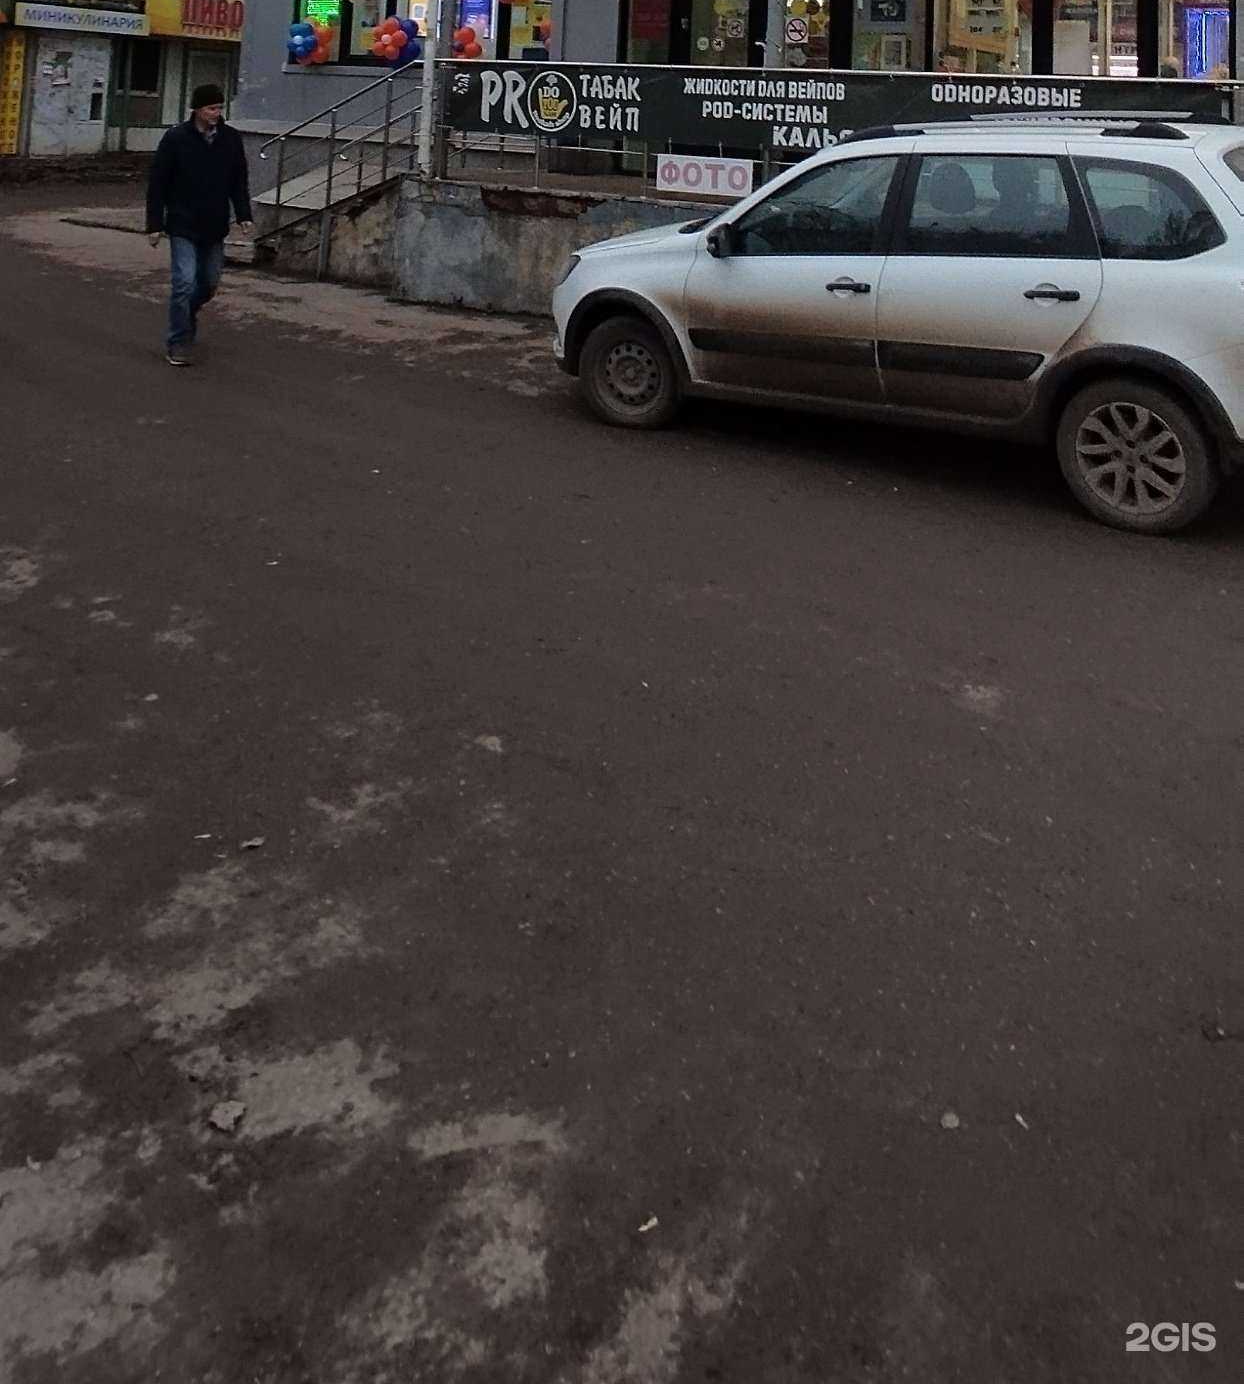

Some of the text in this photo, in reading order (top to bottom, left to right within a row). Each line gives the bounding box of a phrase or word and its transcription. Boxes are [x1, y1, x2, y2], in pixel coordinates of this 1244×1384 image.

[23, 8, 144, 31] МИНИКУЛИНАРИЯ
[579, 74, 642, 102] ТАБАК
[788, 79, 846, 101] ВЕЙПОВ
[578, 103, 641, 133] ВЕЙП
[660, 159, 749, 191] ФОТО
